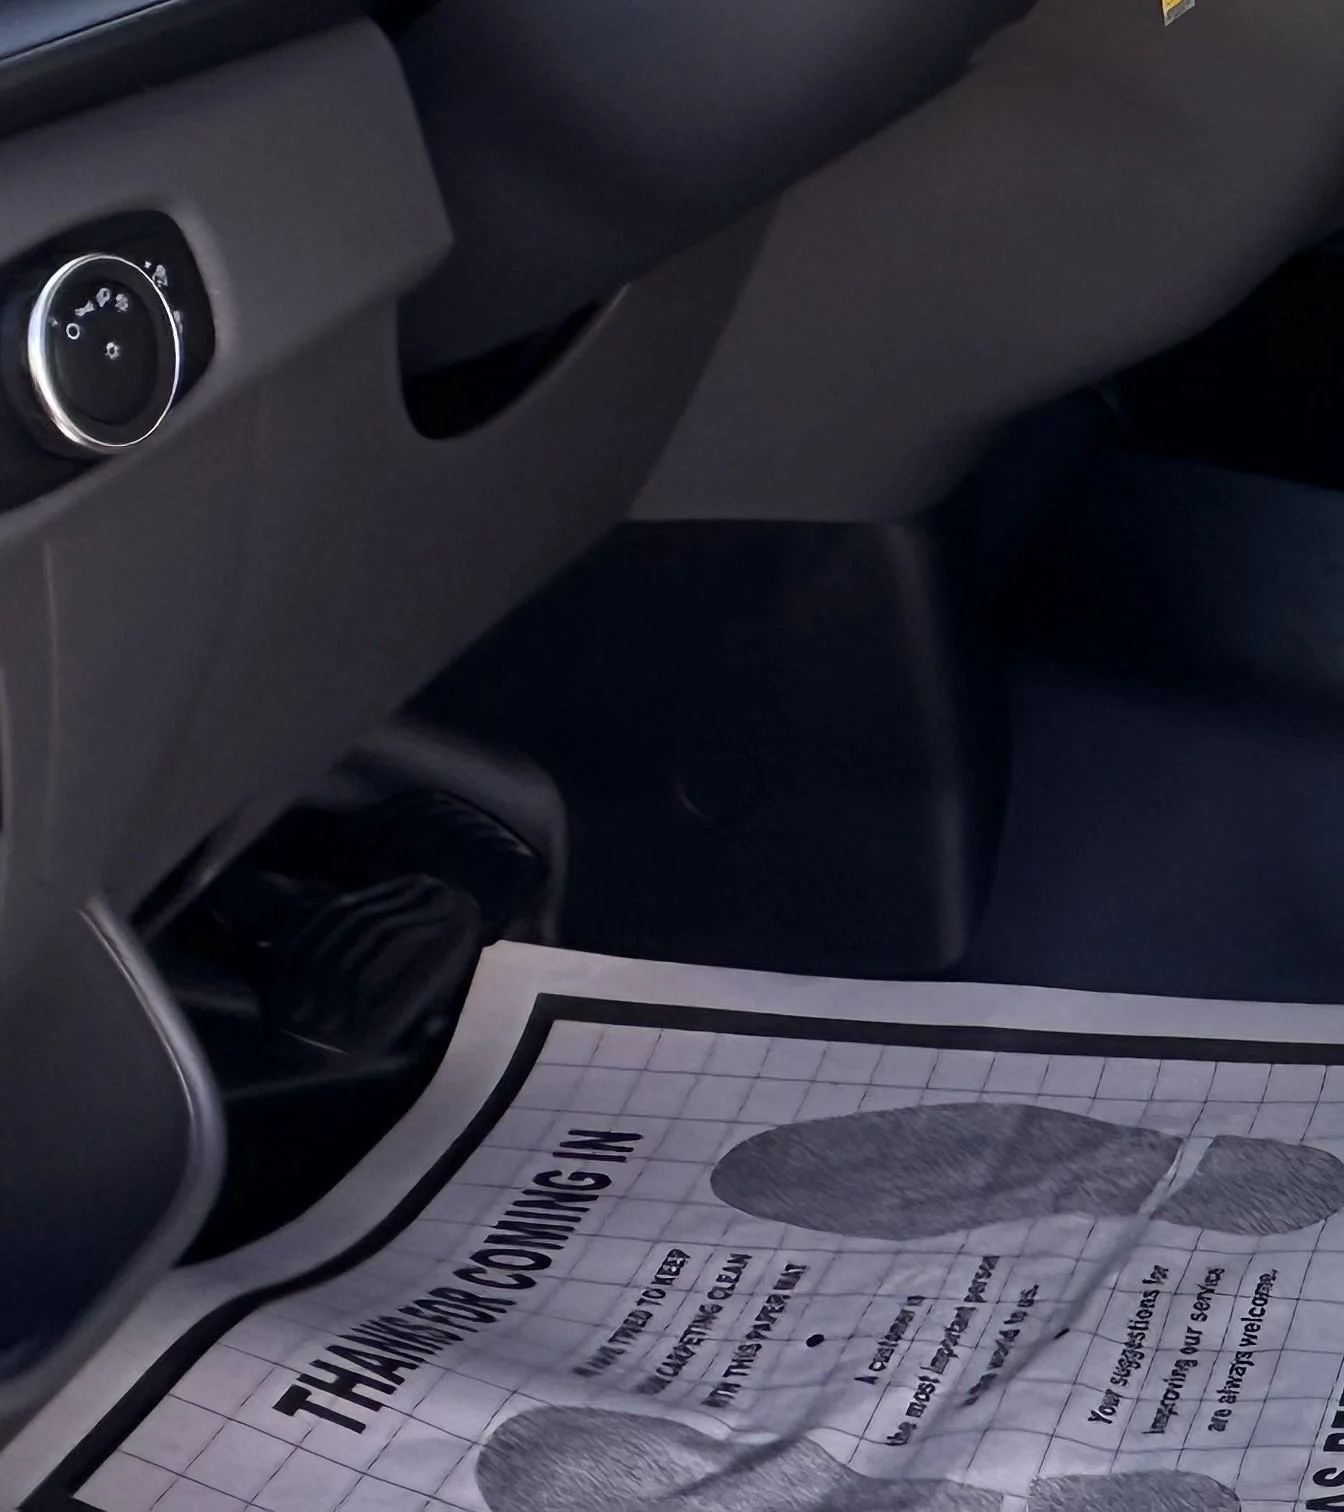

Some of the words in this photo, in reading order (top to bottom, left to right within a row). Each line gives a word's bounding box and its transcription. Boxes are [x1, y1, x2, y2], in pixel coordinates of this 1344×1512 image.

[552, 1129, 644, 1163] IN
[453, 1169, 613, 1290] COMING
[636, 1288, 666, 1307] TO
[707, 1253, 752, 1300] CLEAN
[1190, 1266, 1226, 1322] service
[397, 1287, 518, 1333] FOR
[1239, 1268, 1279, 1348] welcome.
[1110, 1289, 1161, 1387] suggestions
[1180, 1326, 1203, 1355] our
[272, 1314, 464, 1435] THANKS
[1216, 1351, 1255, 1405] always
[1207, 1408, 1232, 1432] are
